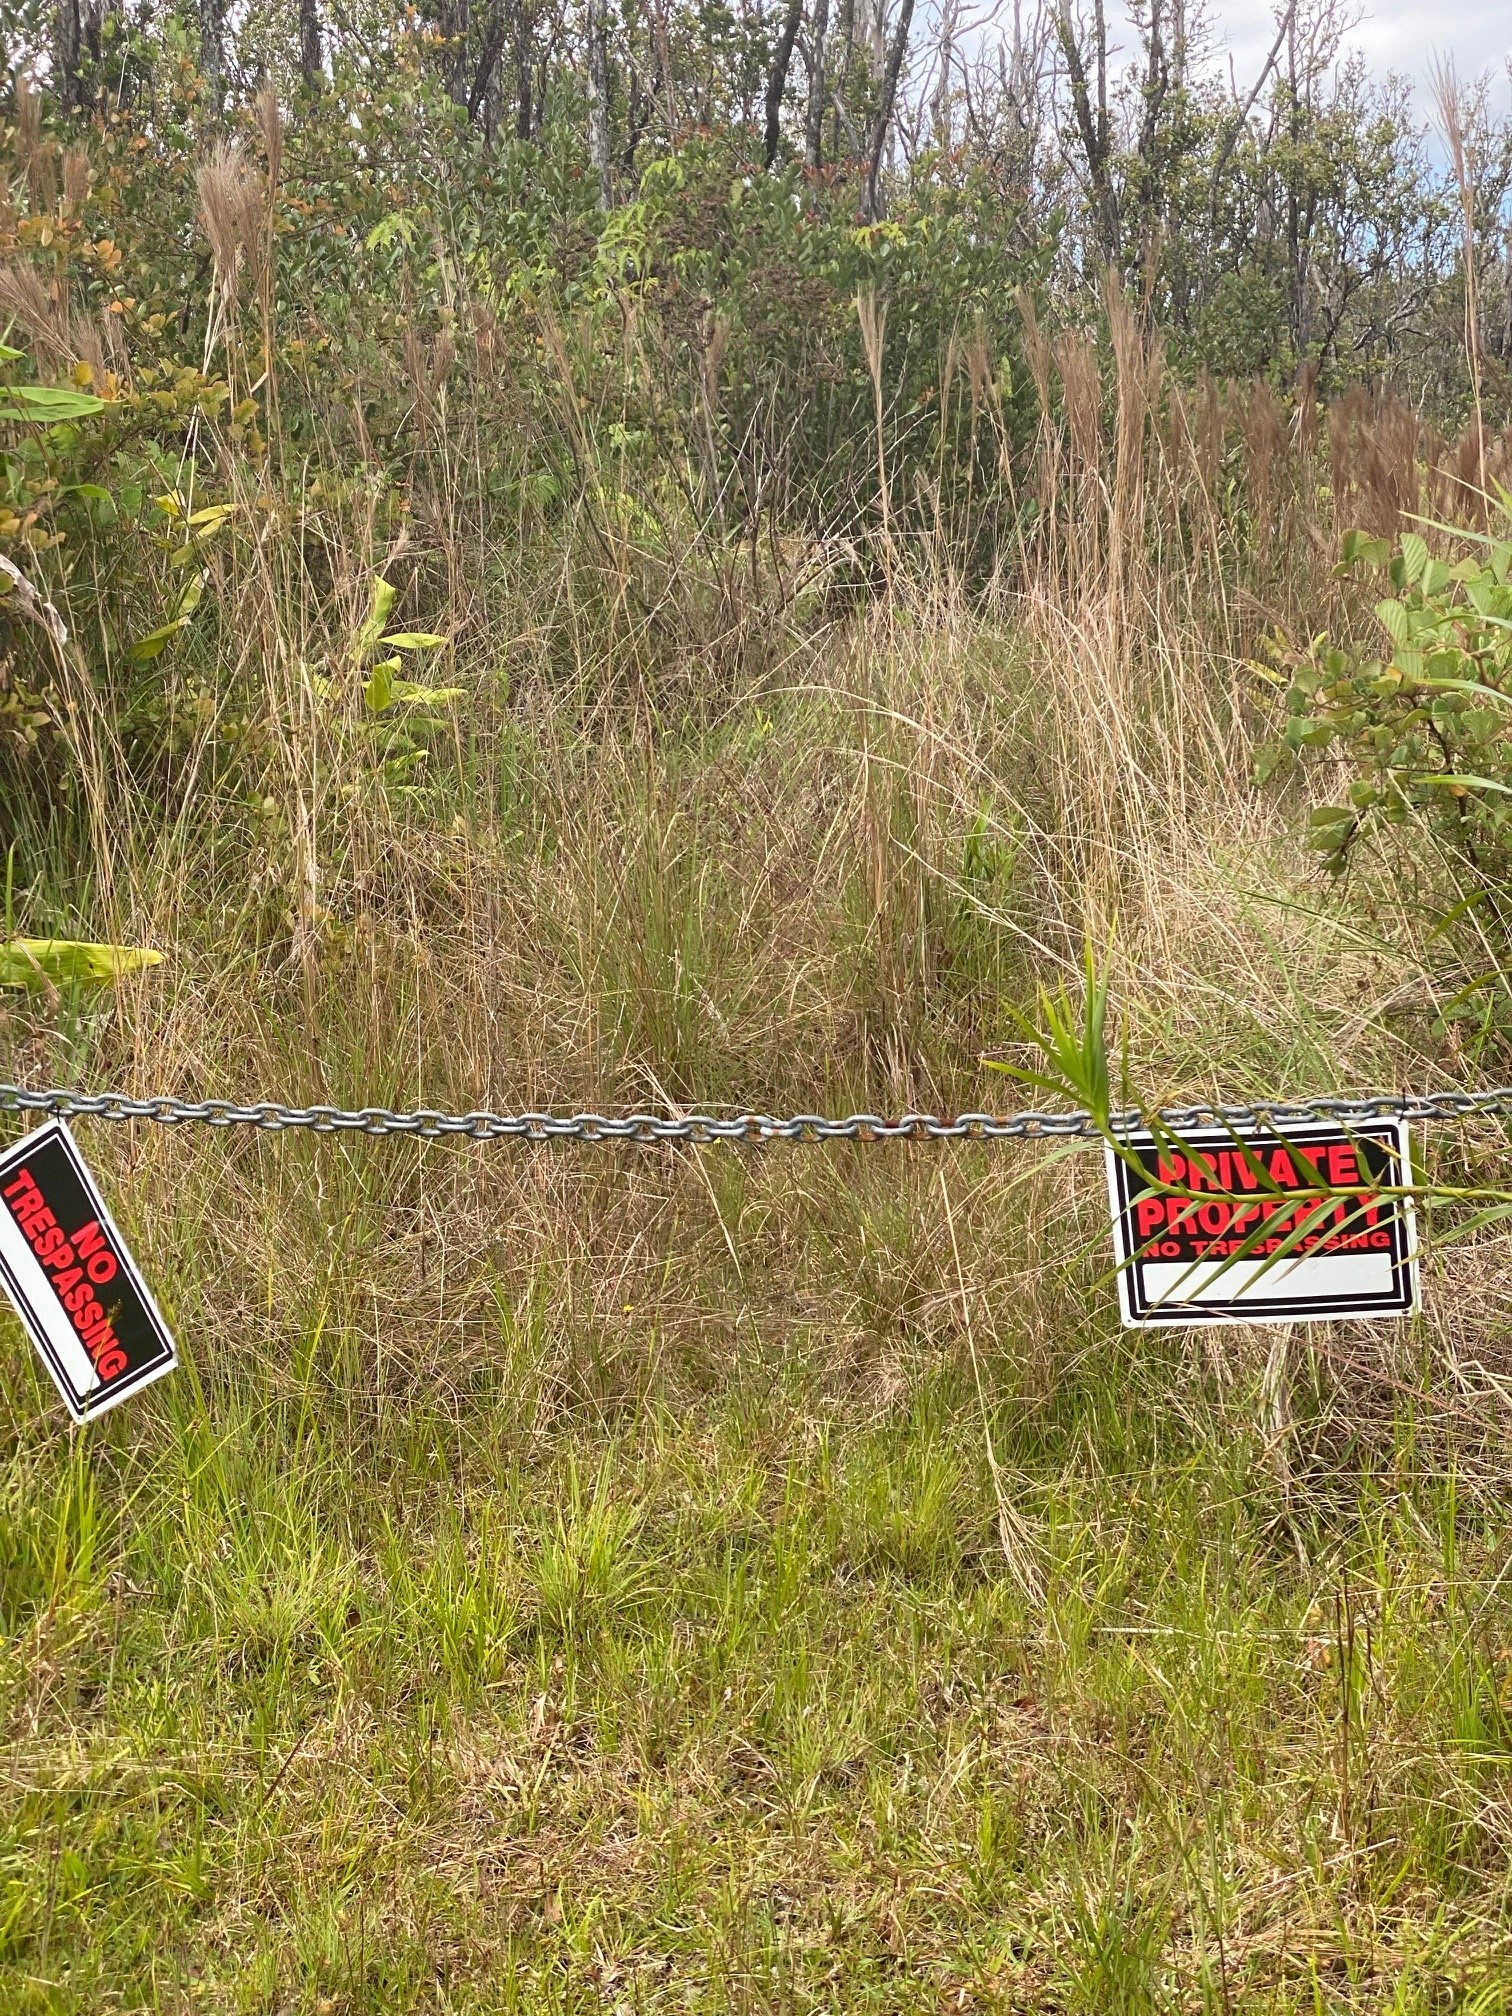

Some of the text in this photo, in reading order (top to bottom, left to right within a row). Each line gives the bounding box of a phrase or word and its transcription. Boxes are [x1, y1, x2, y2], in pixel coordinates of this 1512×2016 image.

[1157, 1145, 1360, 1191] PRIVATE
[3, 1168, 128, 1381] TRESPASSING
[71, 1221, 117, 1284] NO
[1141, 1241, 1181, 1258] NO
